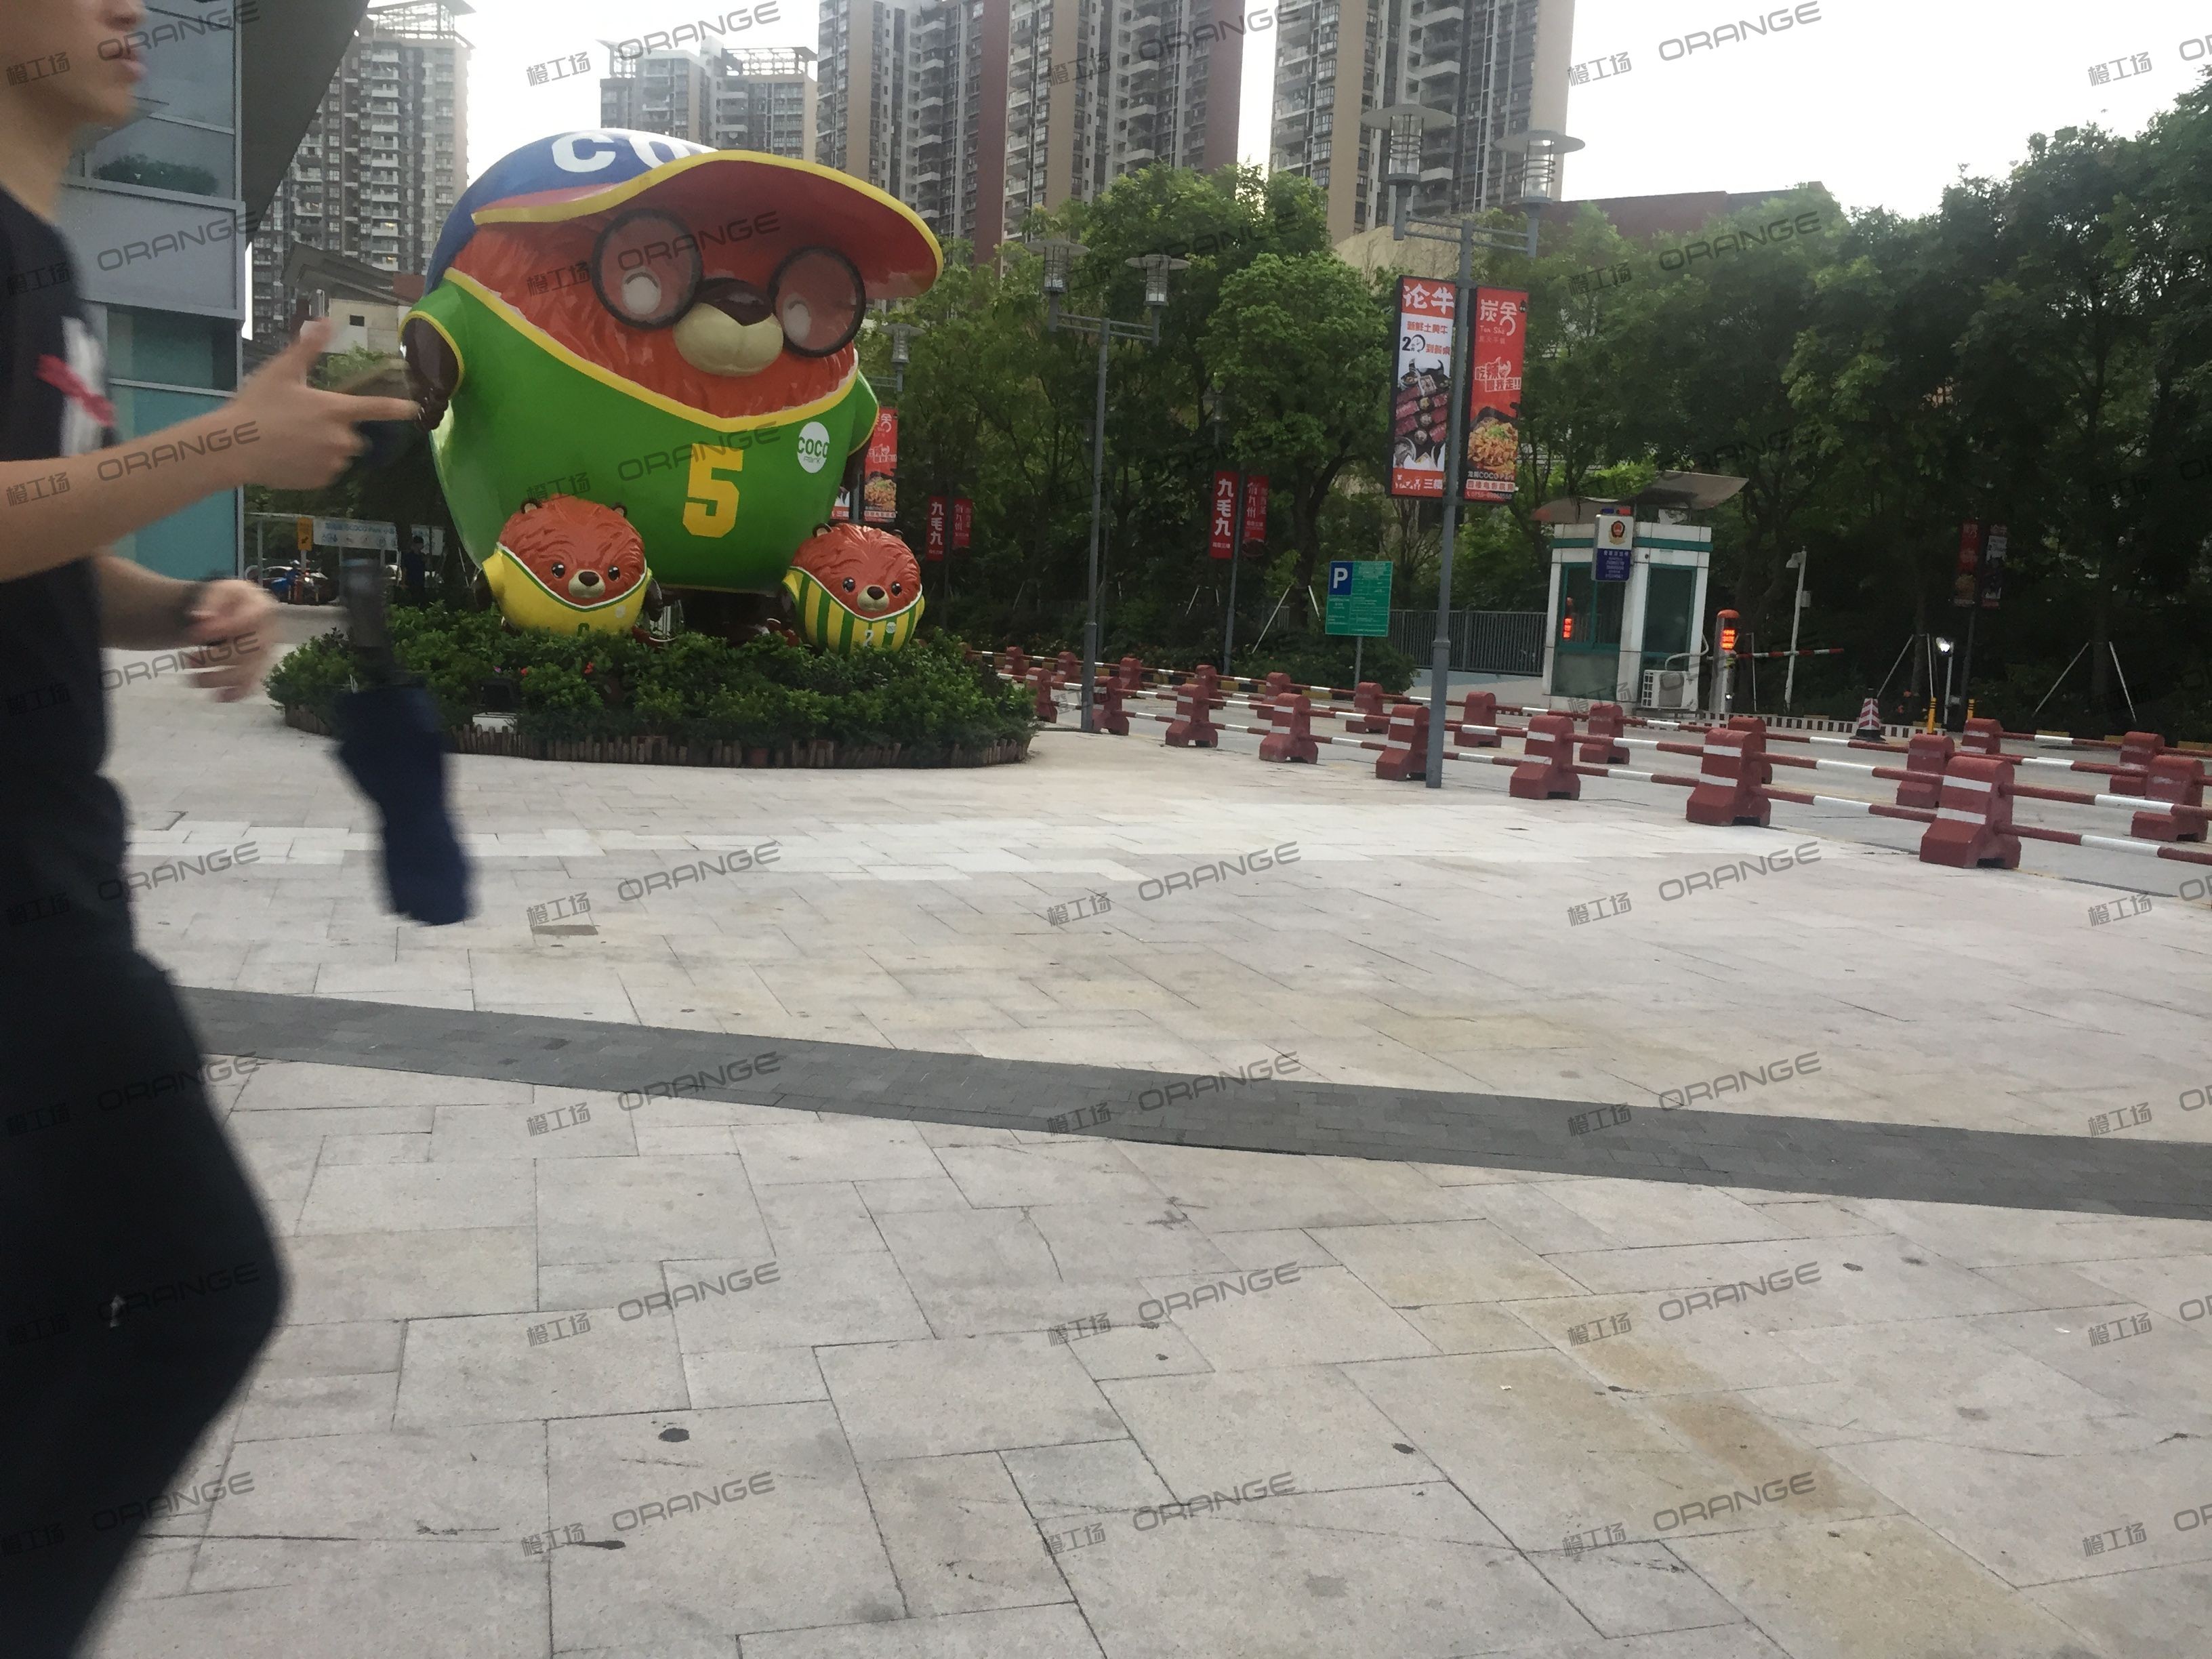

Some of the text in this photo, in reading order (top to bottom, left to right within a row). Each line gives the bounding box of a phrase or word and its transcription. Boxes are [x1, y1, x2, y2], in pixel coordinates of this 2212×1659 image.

[1403, 283, 1454, 314] 论牛
[798, 436, 830, 458] COCO
[682, 443, 744, 538] 5
[1214, 478, 1233, 536] 九毛九
[930, 501, 944, 546] 九毛九
[1333, 568, 1348, 589] P
